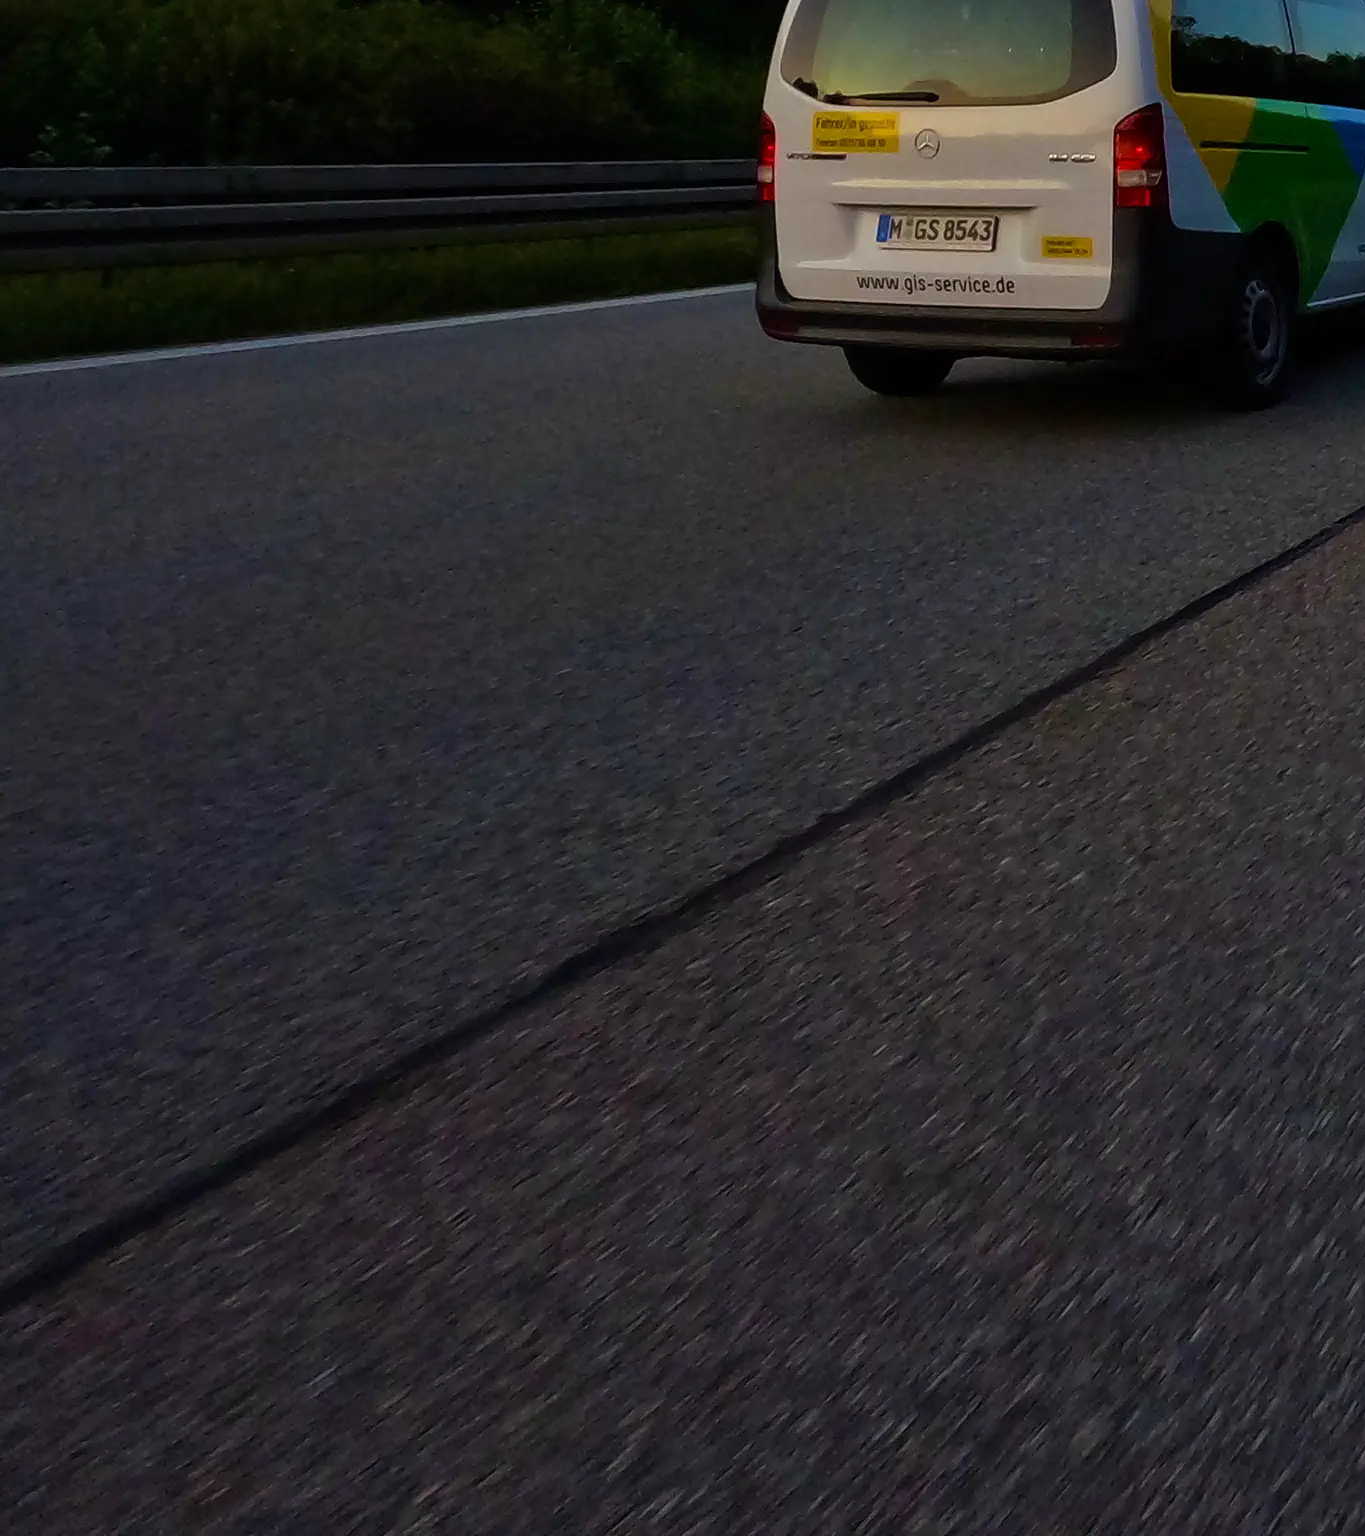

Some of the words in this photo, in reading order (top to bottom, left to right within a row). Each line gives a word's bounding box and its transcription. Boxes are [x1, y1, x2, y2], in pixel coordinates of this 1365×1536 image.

[888, 218, 904, 240] M
[943, 219, 993, 242] 8543
[856, 274, 1016, 295] www.gis-service.de
